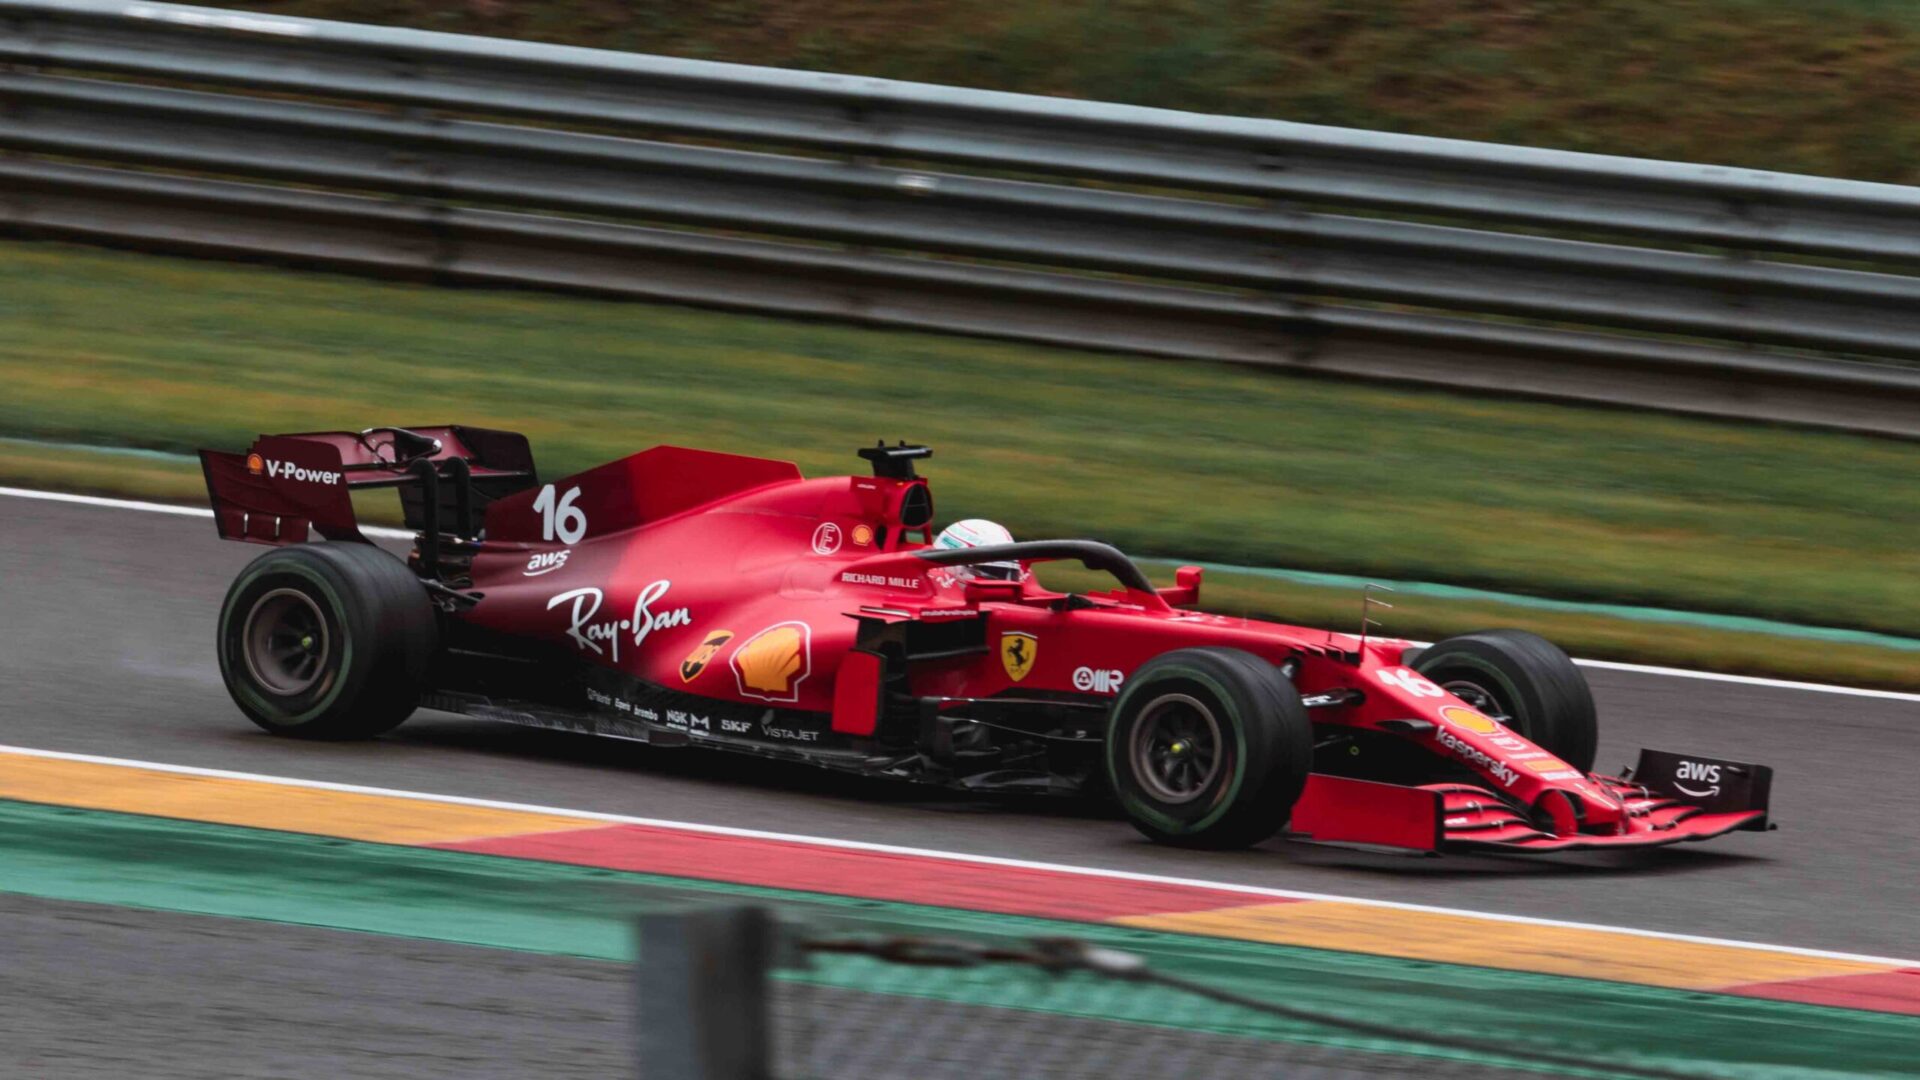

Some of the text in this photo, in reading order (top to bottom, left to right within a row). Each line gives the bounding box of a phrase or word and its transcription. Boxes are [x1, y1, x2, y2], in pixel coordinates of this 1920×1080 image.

[266, 459, 341, 485] V-Power
[532, 484, 587, 545] 16
[527, 550, 571, 570] aws
[841, 572, 919, 589] RICHARD MILLE
[1375, 668, 1445, 698] 16
[666, 709, 688, 724] NGK
[721, 719, 752, 733] SKF
[1434, 725, 1520, 787] kaspersky
[1676, 760, 1721, 783] aws
